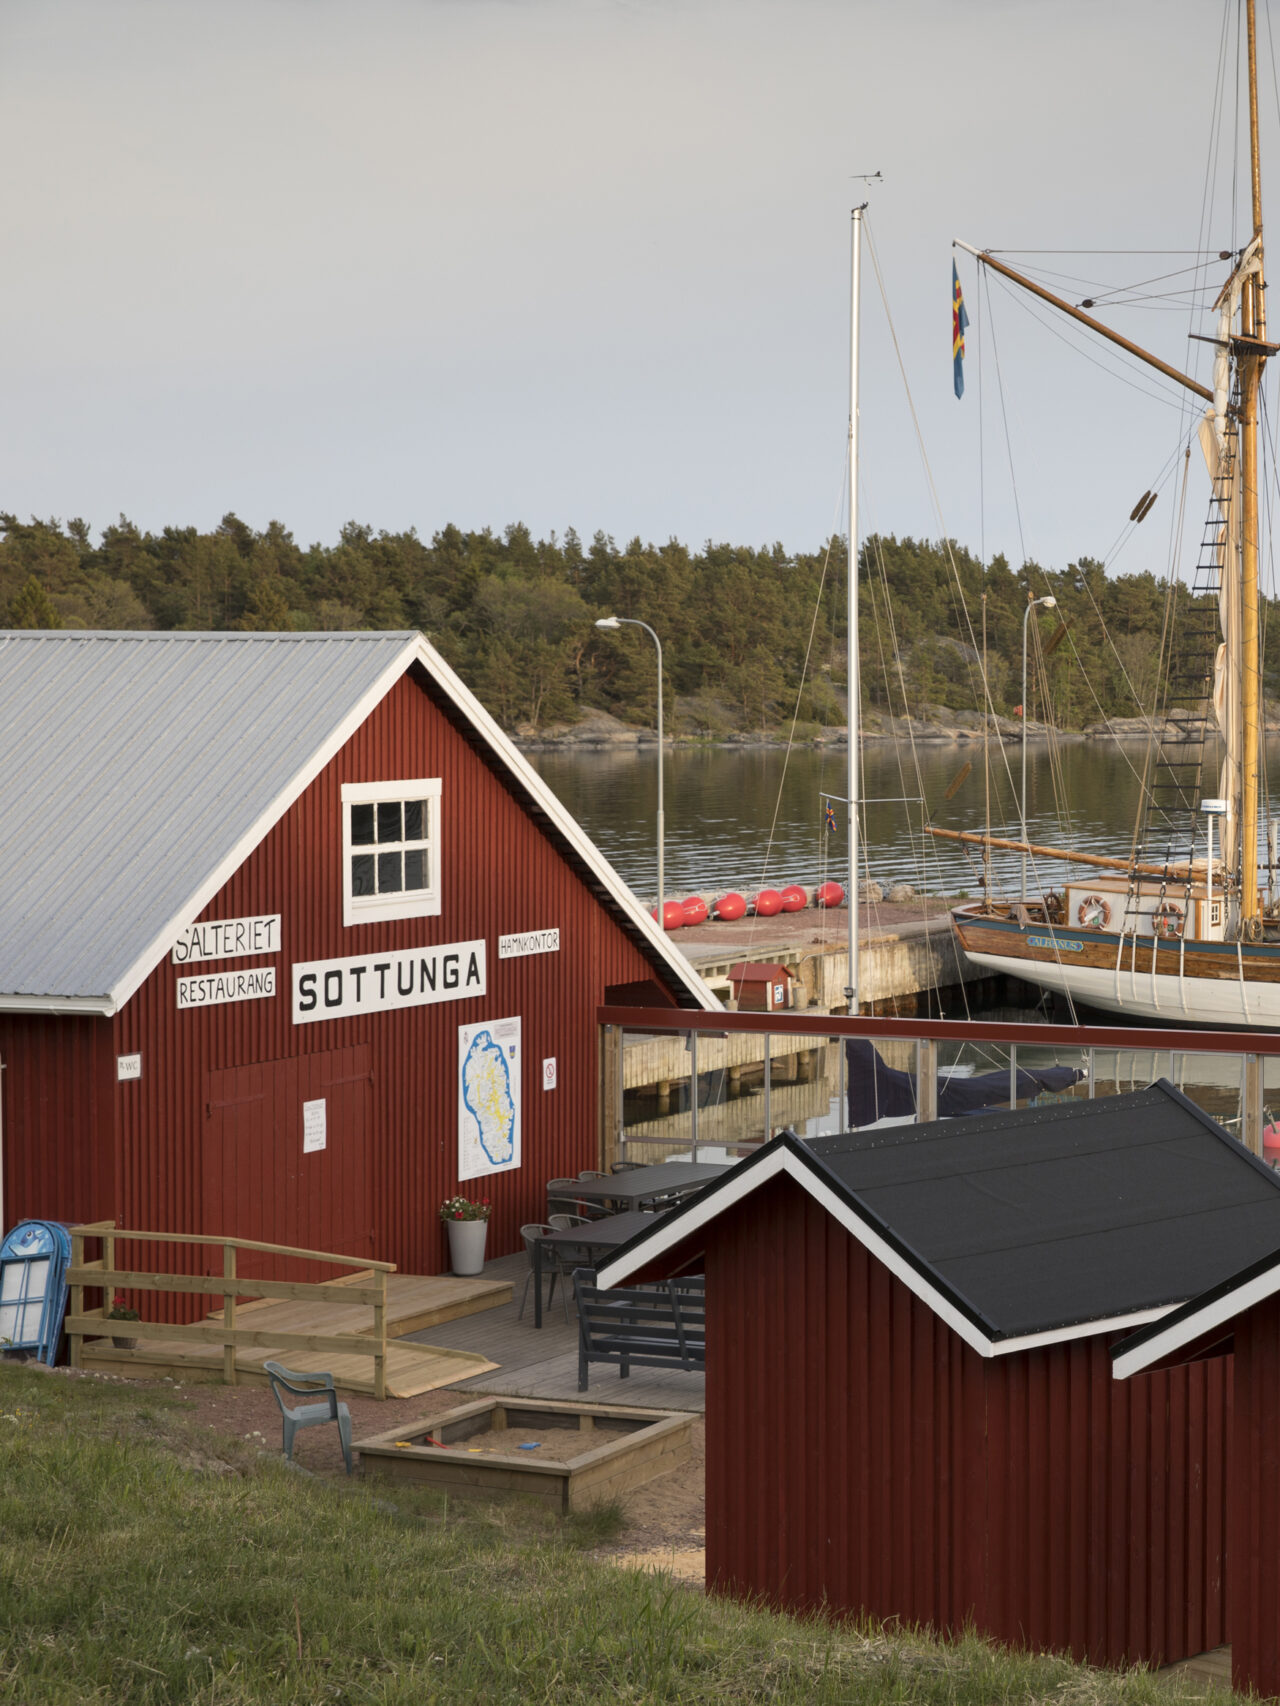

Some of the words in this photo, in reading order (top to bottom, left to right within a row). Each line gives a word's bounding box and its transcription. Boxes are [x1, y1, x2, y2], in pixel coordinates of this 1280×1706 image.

[501, 931, 558, 954] HAMNKONTOR
[180, 971, 273, 1004] RESTAURANG
[299, 951, 481, 1012] SOTTUNGA
